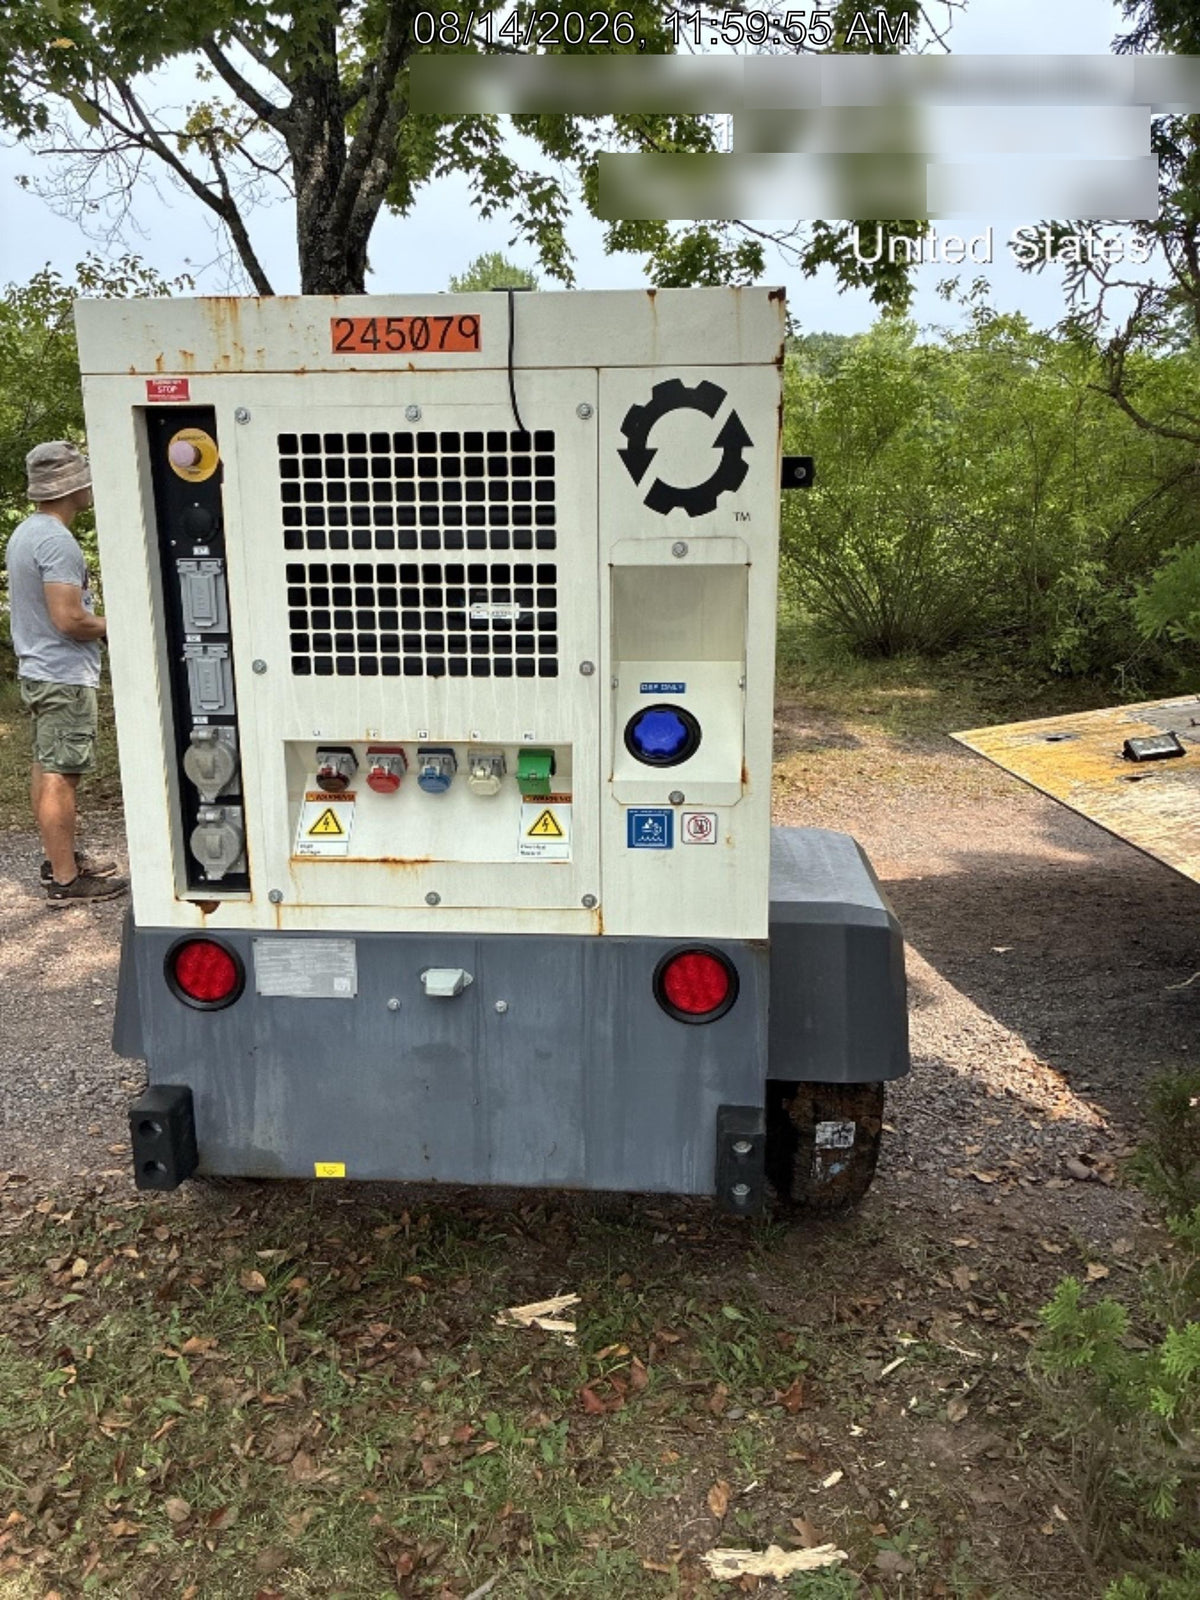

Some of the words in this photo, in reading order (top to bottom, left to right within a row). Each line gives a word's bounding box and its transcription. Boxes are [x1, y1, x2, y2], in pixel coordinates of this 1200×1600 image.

[335, 315, 479, 351] 245079
[157, 385, 177, 394] STOP
[732, 511, 751, 522] TM
